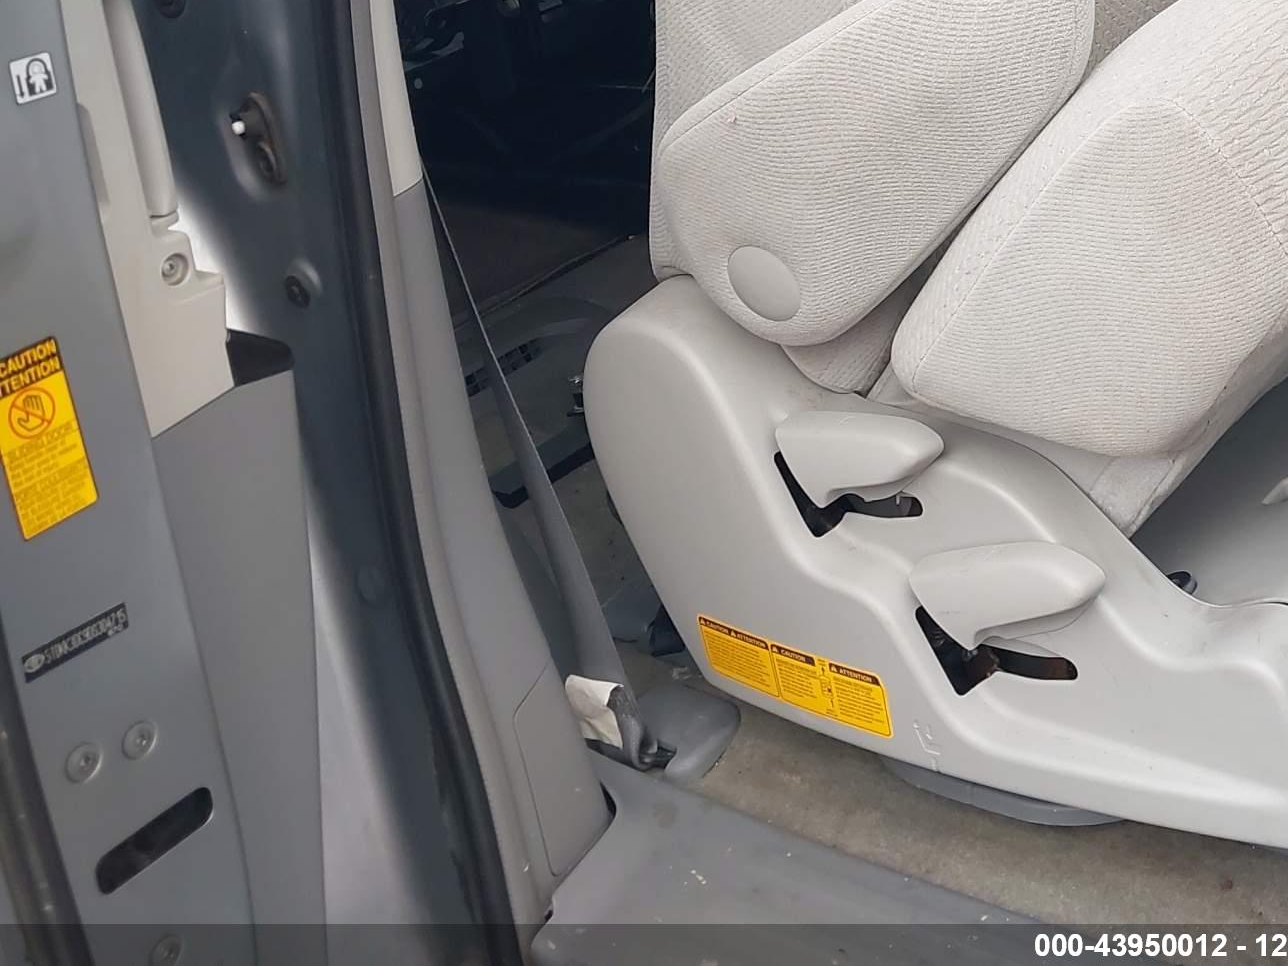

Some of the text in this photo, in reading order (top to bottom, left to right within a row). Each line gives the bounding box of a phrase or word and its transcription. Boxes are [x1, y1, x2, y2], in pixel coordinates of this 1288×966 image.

[0, 338, 57, 378] CAUTION
[0, 355, 60, 397] TTENTION
[780, 649, 806, 663] CAUTION
[839, 666, 873, 683] ATTENTION
